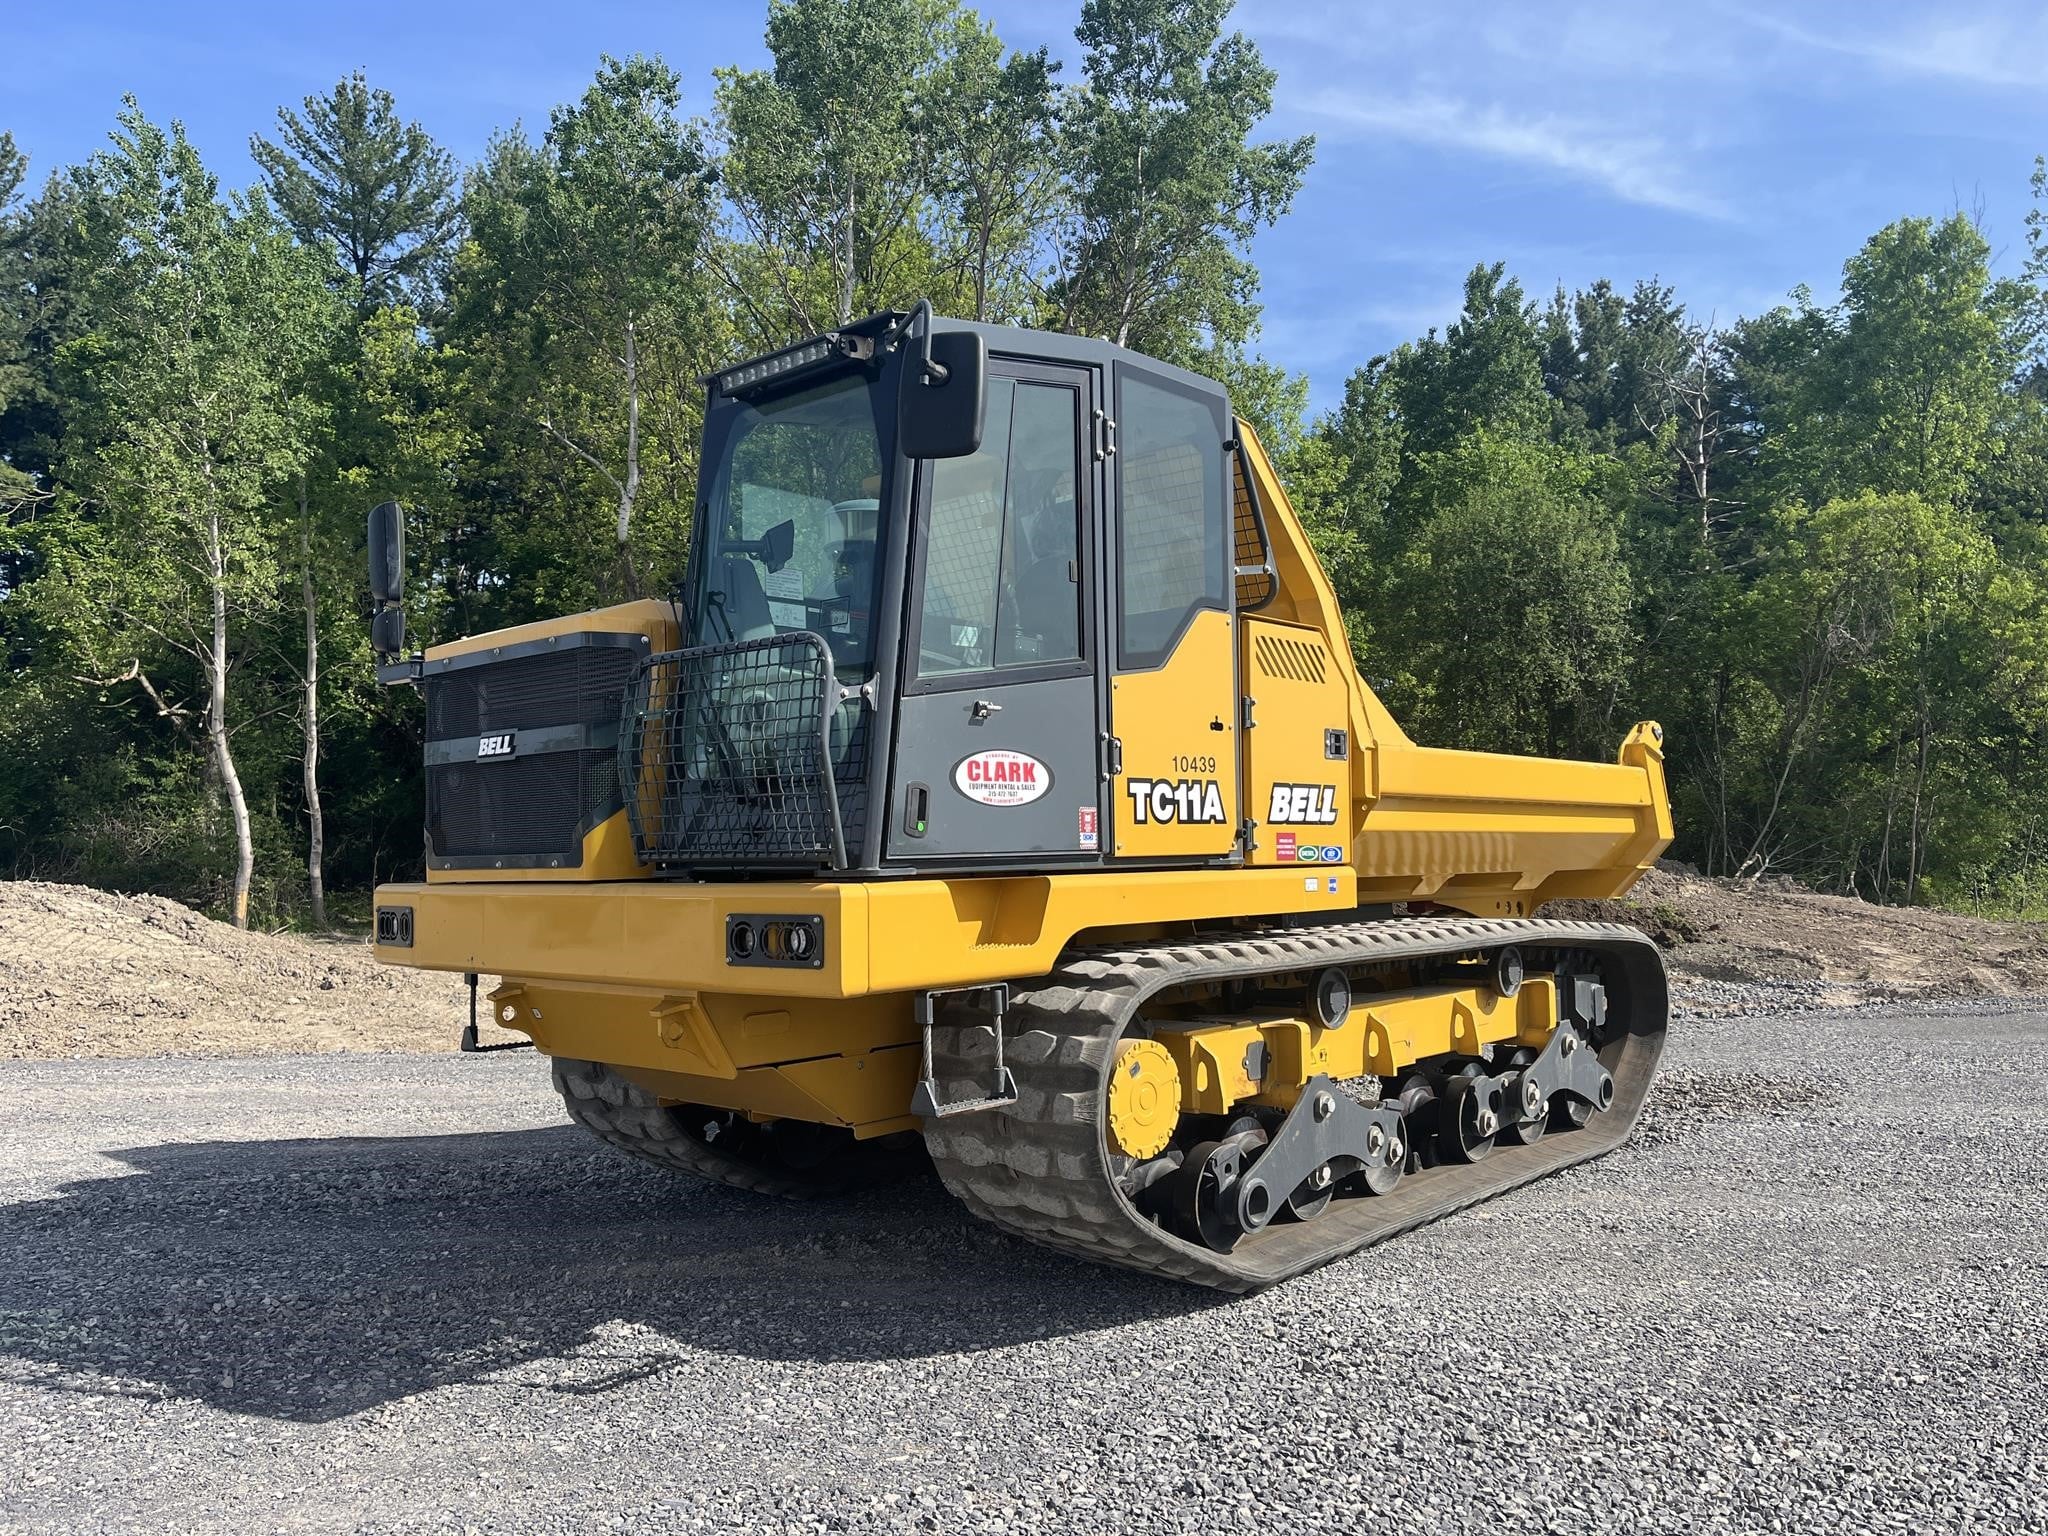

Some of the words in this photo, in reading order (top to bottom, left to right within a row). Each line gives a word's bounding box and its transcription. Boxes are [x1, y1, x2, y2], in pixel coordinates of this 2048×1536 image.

[478, 735, 511, 756] BELL
[967, 760, 1036, 783] CLARK
[1172, 755, 1216, 773] 10439
[968, 782, 997, 791] EQUIPMENT
[998, 783, 1016, 791] RENTAL
[1021, 783, 1036, 791] SALES
[1127, 777, 1227, 824] TC11A
[1267, 782, 1338, 825] BELL
